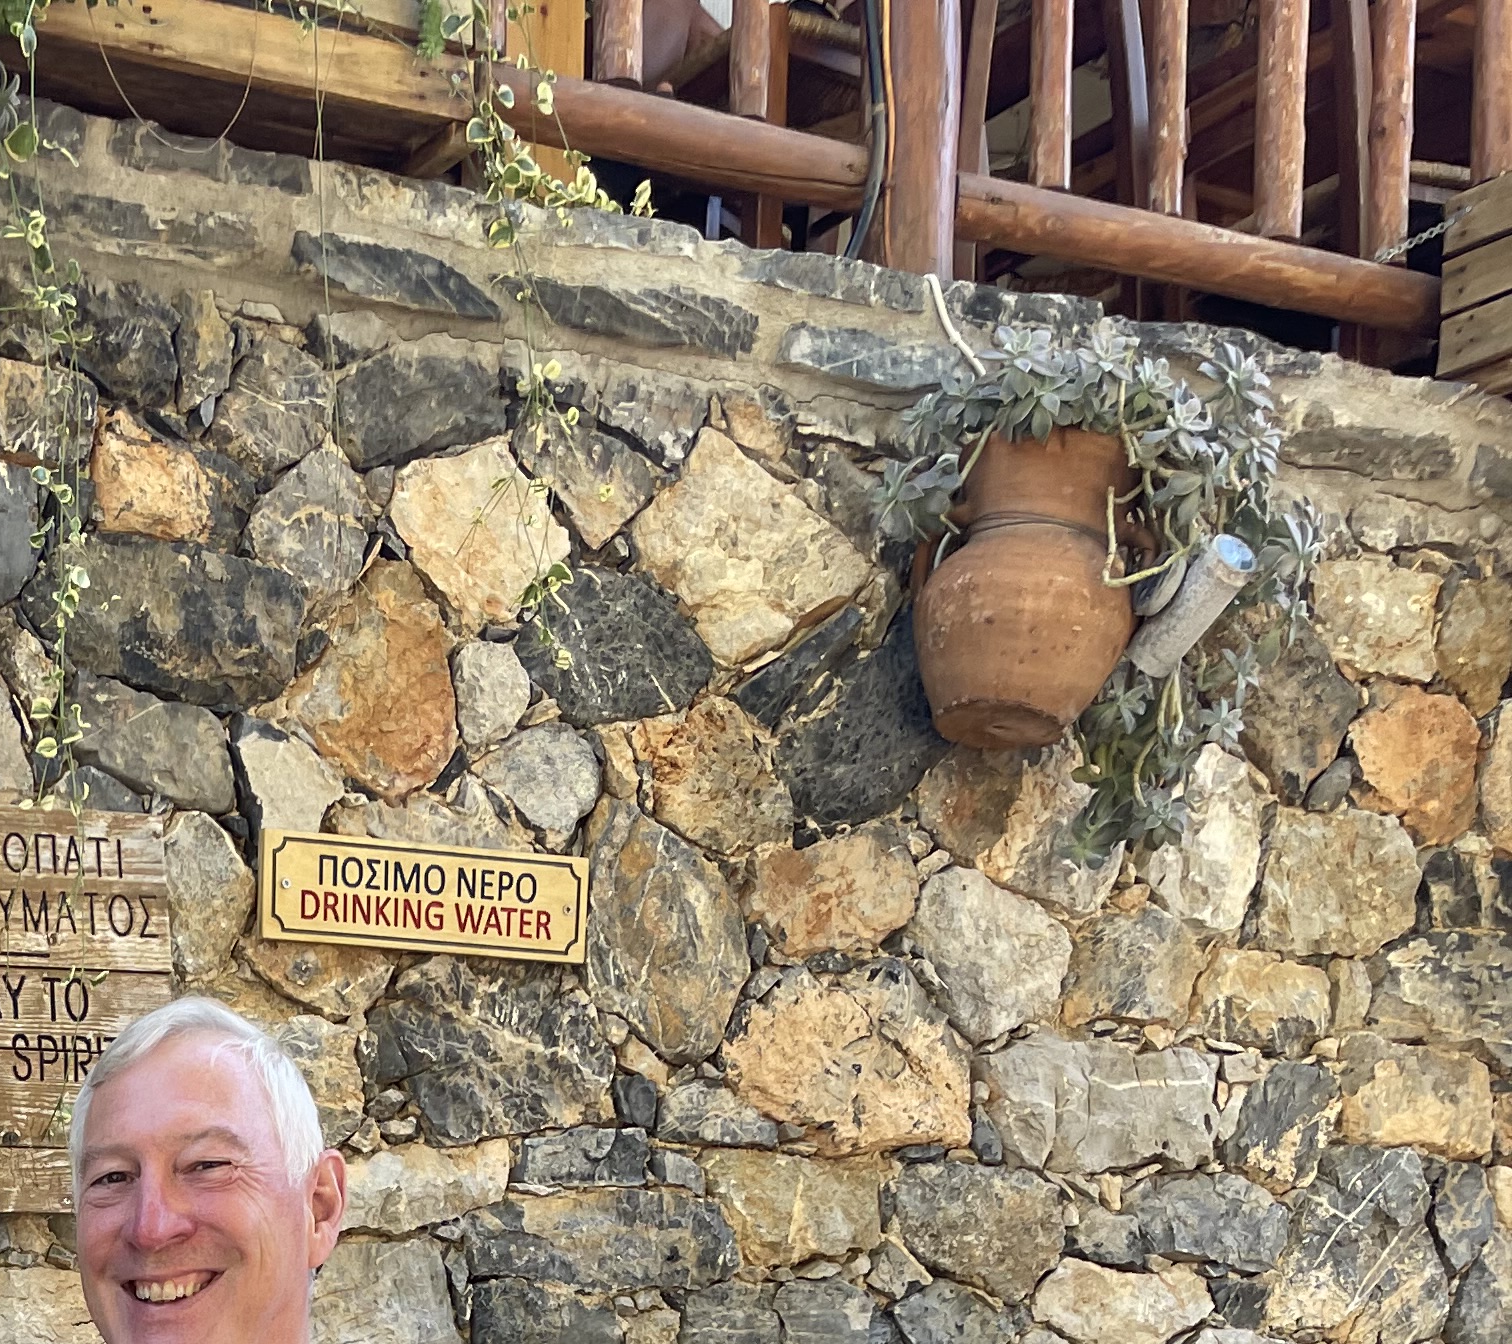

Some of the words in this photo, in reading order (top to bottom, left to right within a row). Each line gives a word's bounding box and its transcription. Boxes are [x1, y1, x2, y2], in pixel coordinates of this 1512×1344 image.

[319, 855, 445, 895] ΠΟΣΙΜΟ
[457, 868, 537, 903] ΝΕΡΟ
[300, 890, 444, 930] DRINKING
[455, 903, 551, 940] WATER
[43, 978, 88, 1022] TO
[12, 1033, 117, 1082] SPIR
